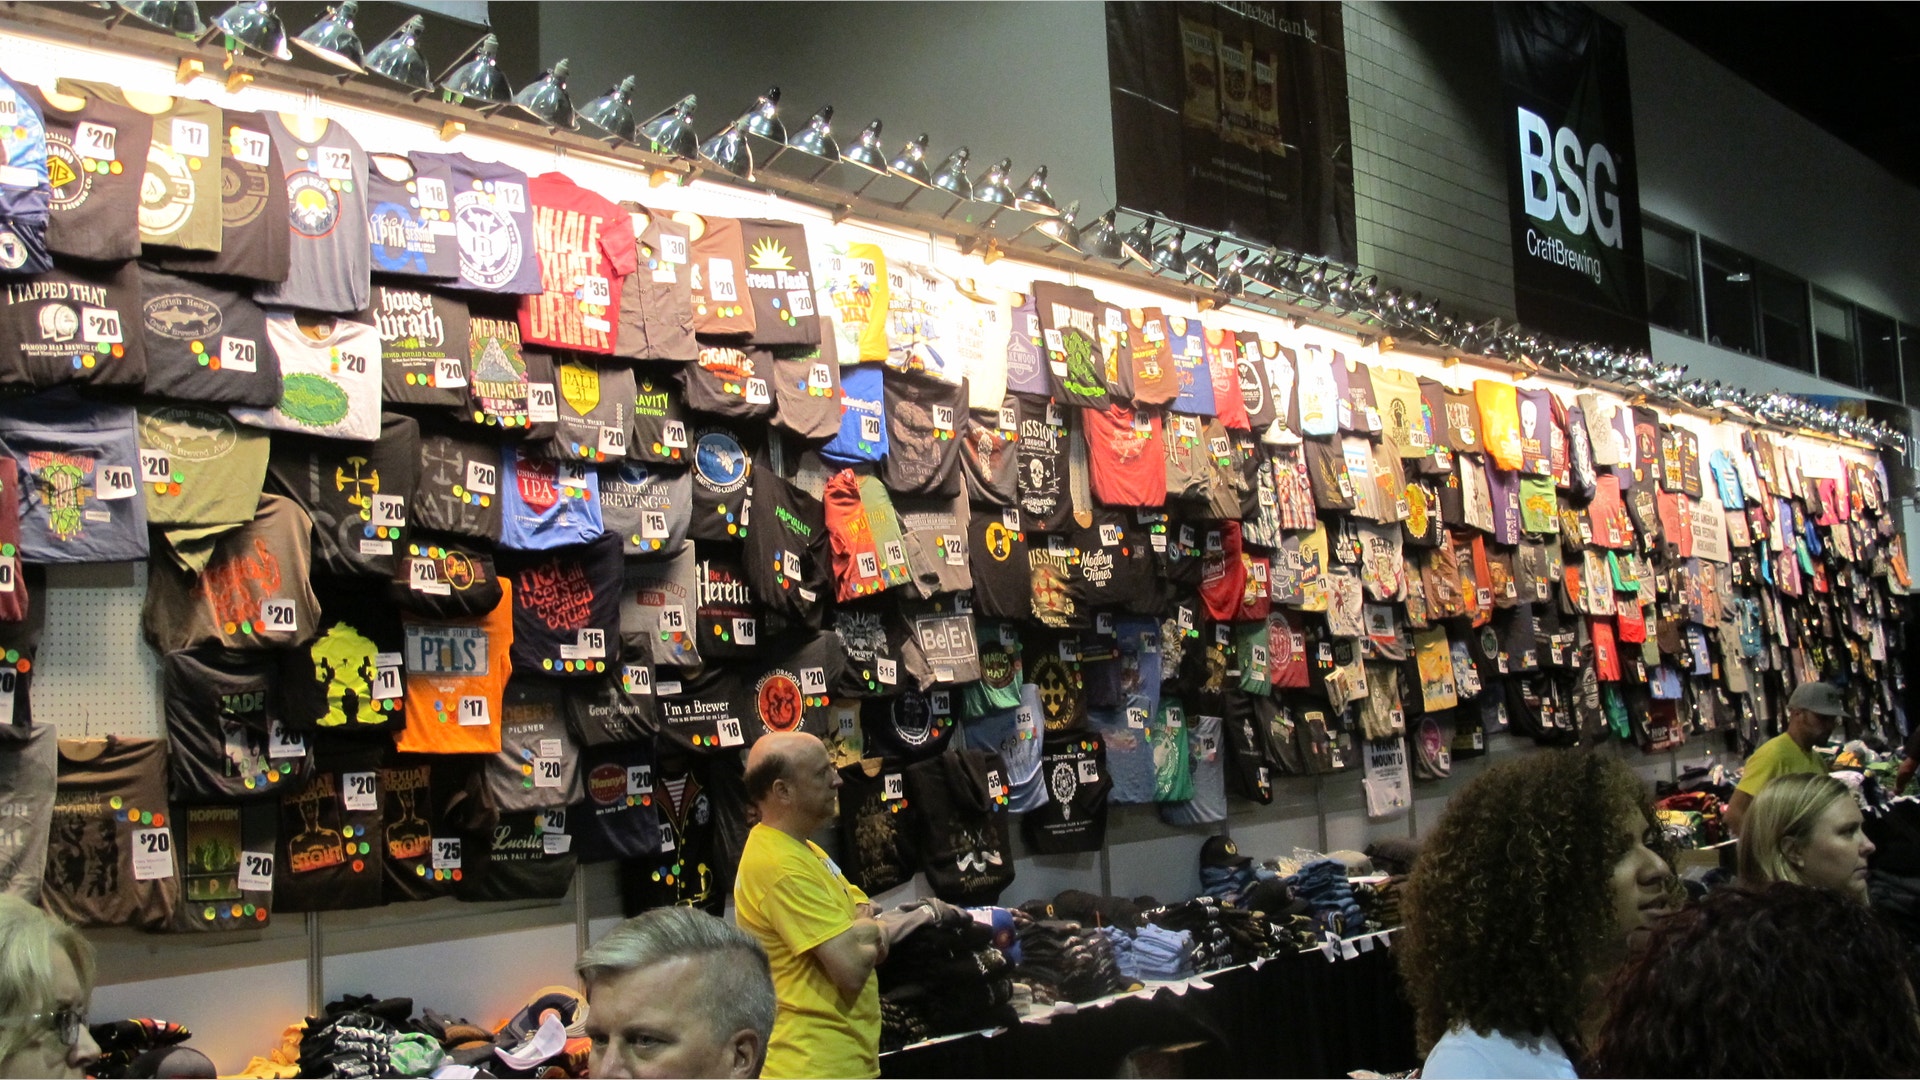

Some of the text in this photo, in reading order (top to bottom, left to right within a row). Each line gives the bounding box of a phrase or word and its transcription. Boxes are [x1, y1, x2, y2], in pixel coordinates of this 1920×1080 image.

[1241, 2, 1318, 44] pretzel can be
[87, 126, 113, 150] $20
[182, 125, 202, 145] $17
[243, 136, 264, 157] $17
[325, 153, 350, 170] $22
[1518, 106, 1623, 249] BSG
[425, 186, 444, 202] $18
[498, 187, 519, 205] $12
[532, 205, 603, 257] NHALE
[667, 239, 684, 255] $30
[1527, 229, 1601, 284] CraftBrewing
[776, 271, 809, 289] Flash
[8, 282, 107, 307] I TAPPED THAT
[589, 282, 608, 296] $35
[151, 298, 210, 313] Dogfish Head
[380, 287, 422, 313] hops
[90, 317, 117, 336] $20
[172, 328, 199, 337] Brewed
[373, 305, 444, 347] wrath
[469, 318, 520, 343] EMERALD
[229, 343, 255, 361] $20
[341, 352, 365, 374] $20
[441, 362, 462, 379] $20
[564, 372, 596, 388] PALE
[813, 368, 828, 382] $15
[473, 381, 528, 398] TRIANGLE
[531, 390, 554, 405] $20
[576, 388, 587, 400] 31
[750, 381, 767, 397] $20
[490, 400, 516, 410] IPA
[1002, 409, 1015, 423] $25
[667, 425, 684, 442] $20
[865, 417, 879, 434] $20
[1182, 419, 1195, 432] $45
[152, 435, 229, 457] Craft Brewed Ales
[604, 430, 624, 447] $20
[1212, 439, 1227, 452] $30
[1412, 432, 1423, 444] $30
[142, 456, 170, 476] $20
[566, 462, 585, 480] $20
[104, 470, 132, 490] $40
[473, 465, 494, 486] $20
[523, 479, 553, 499] IPA
[623, 484, 651, 494] MOON
[652, 485, 669, 497] BAY
[600, 492, 657, 508] BREWING
[380, 501, 402, 520] $20
[1006, 510, 1017, 524] $18
[646, 515, 665, 531] $15
[1102, 529, 1116, 541] $20
[888, 545, 901, 559] $15
[947, 540, 960, 552] $22
[862, 557, 875, 572] $15
[1081, 549, 1113, 568] Modern
[414, 563, 436, 580] $20
[520, 565, 563, 592] not
[710, 570, 720, 580] Be
[1083, 567, 1112, 581] Times
[519, 583, 570, 608] beers
[537, 586, 594, 617] created
[642, 594, 660, 604] RVA
[268, 604, 294, 625] $20
[546, 606, 591, 630] equal
[664, 611, 681, 626] $15
[738, 622, 754, 637] $18
[921, 626, 967, 650] Be Er
[583, 632, 602, 649] $15
[421, 637, 476, 672] PILS
[377, 670, 395, 688] $17
[630, 669, 649, 685] $20
[776, 668, 802, 688] DRAGON
[805, 672, 824, 686] $20
[879, 666, 895, 677] $15
[987, 668, 1005, 679] HAT
[221, 692, 265, 712] JADE
[464, 700, 483, 717] $17
[664, 700, 729, 716] I'm a Brewer
[839, 717, 853, 728] $15
[1017, 714, 1031, 723] $25
[1130, 709, 1142, 723] $25
[509, 724, 544, 734] PILSNER
[723, 722, 739, 737] $18
[1652, 727, 1668, 738] HOP
[1203, 737, 1214, 749] $25
[1372, 753, 1396, 768] MOUNT
[540, 762, 561, 778] $20
[1083, 764, 1097, 775] $35
[350, 776, 374, 795] $20
[590, 775, 626, 789] Manny's
[631, 772, 650, 789] $20
[889, 780, 901, 793] $20
[189, 808, 239, 822] HOPPYUM
[141, 833, 169, 853] $20
[491, 825, 542, 849] Lucille
[293, 846, 344, 870] STOUT
[438, 842, 461, 860] $25
[531, 852, 544, 860] ALE
[246, 855, 272, 876] $20
